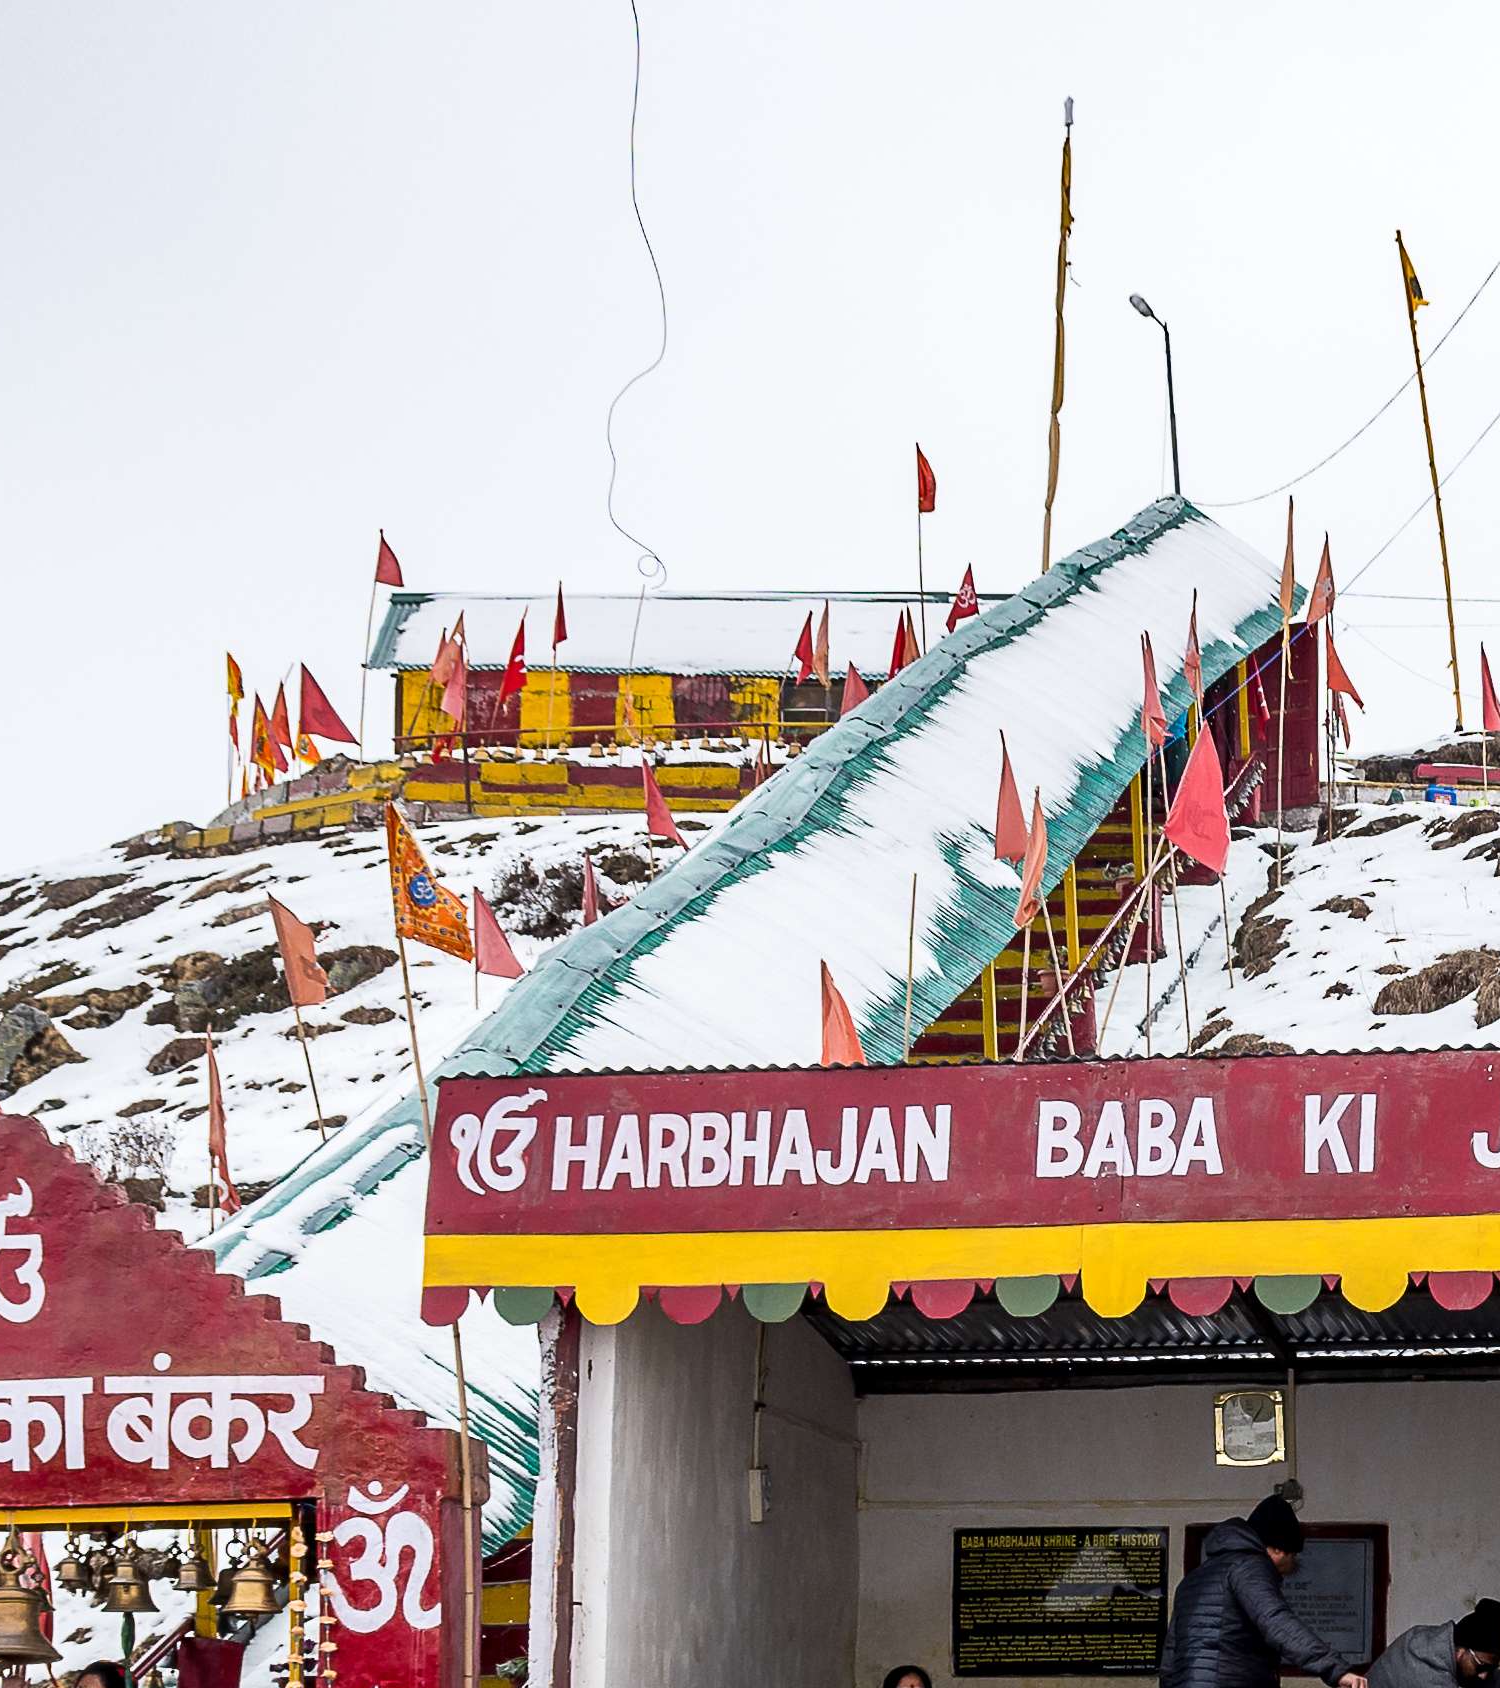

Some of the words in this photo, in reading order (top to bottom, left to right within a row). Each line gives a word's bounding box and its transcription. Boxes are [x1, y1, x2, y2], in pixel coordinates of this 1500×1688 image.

[551, 1104, 952, 1191] HARBHAJAN
[1036, 1096, 1224, 1180] BABA
[1304, 1093, 1377, 1175] KI
[104, 1352, 325, 1470] बंकर
[961, 1536, 984, 1548] BABA
[987, 1535, 1041, 1548] HARBHAJAN
[1044, 1535, 1076, 1547] SHRINE
[1084, 1535, 1091, 1546] A
[1093, 1534, 1118, 1547] BRIEF
[1121, 1534, 1160, 1546] HISTORY
